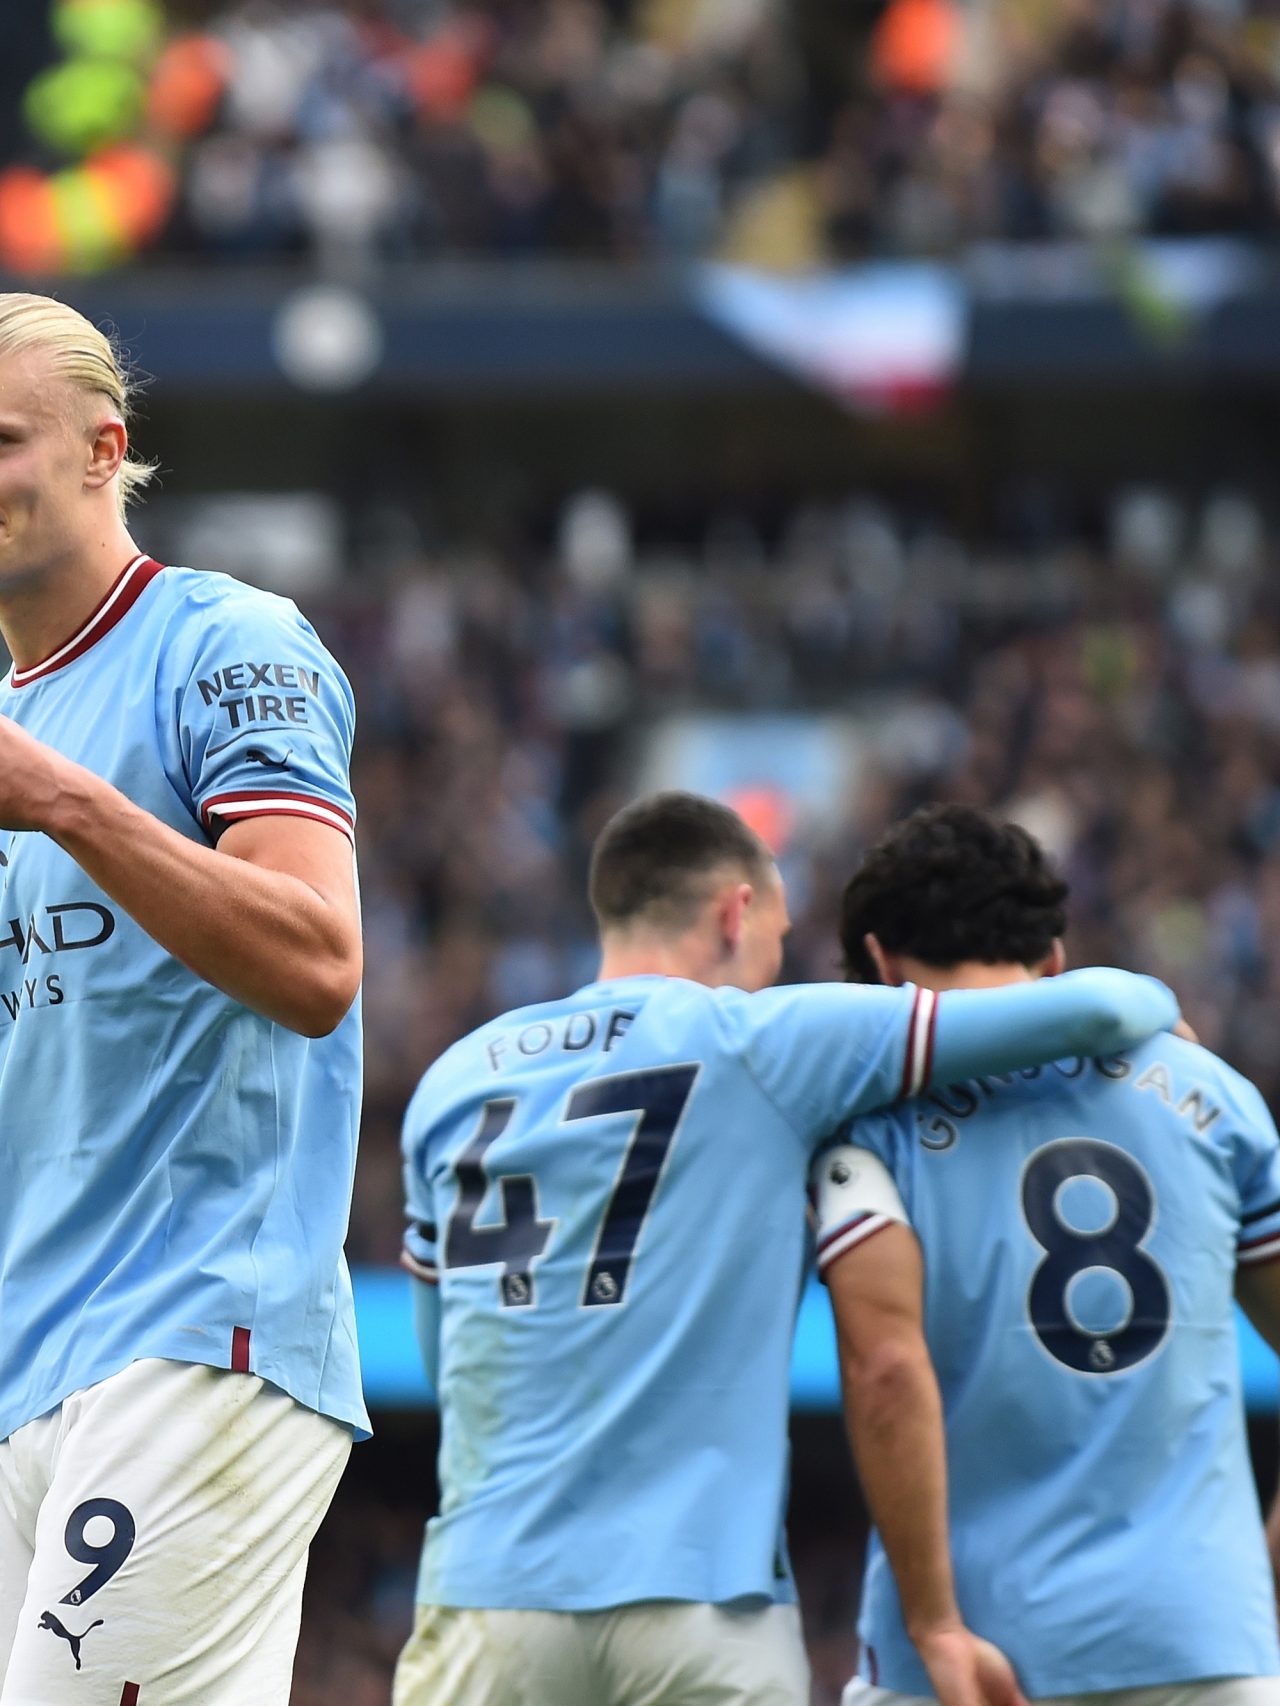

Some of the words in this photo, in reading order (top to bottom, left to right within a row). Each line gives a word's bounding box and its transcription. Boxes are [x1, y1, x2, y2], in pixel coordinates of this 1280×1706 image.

[197, 661, 320, 706] NEXEN
[219, 695, 308, 729] TIRE
[442, 1061, 702, 1308] 47
[1022, 1137, 1172, 1376] 8
[58, 1497, 136, 1607] 9
